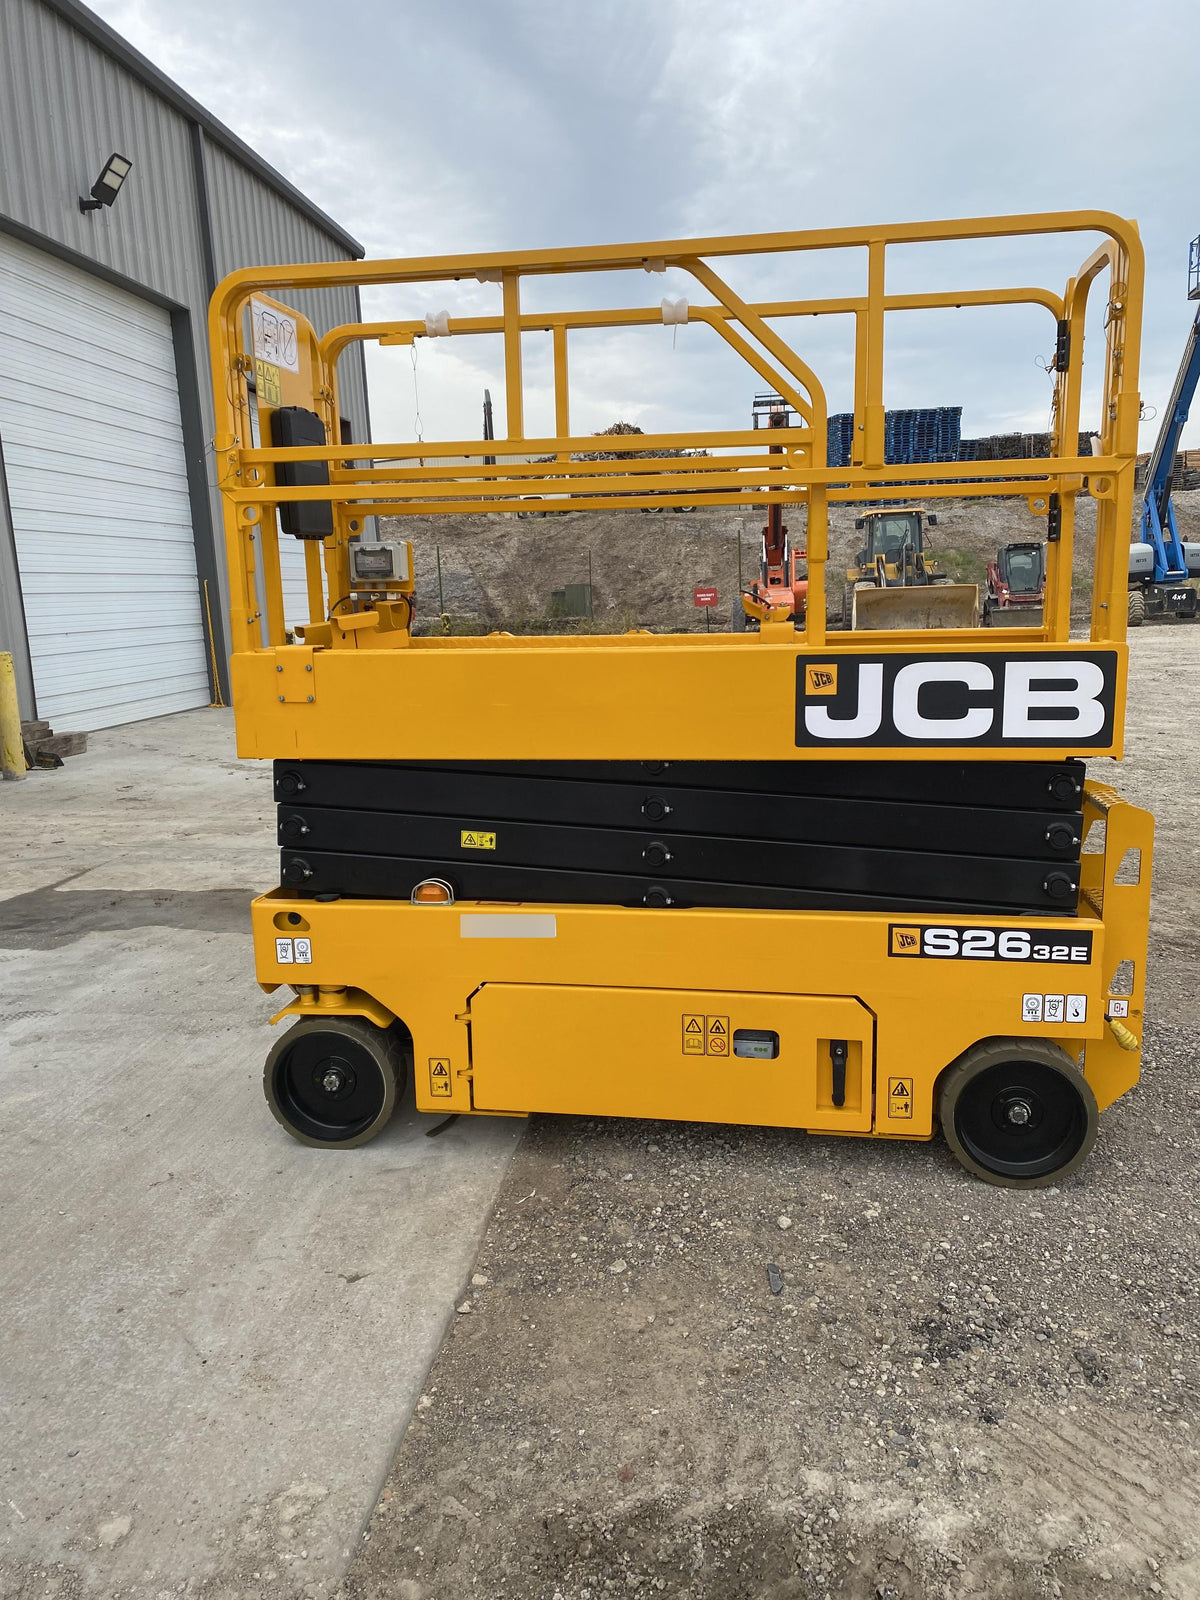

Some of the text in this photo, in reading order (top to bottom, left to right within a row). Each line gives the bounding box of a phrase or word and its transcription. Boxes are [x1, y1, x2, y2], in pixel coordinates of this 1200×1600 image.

[812, 671, 833, 687] JCB
[804, 661, 1106, 739] JCB
[899, 934, 917, 947] JCB
